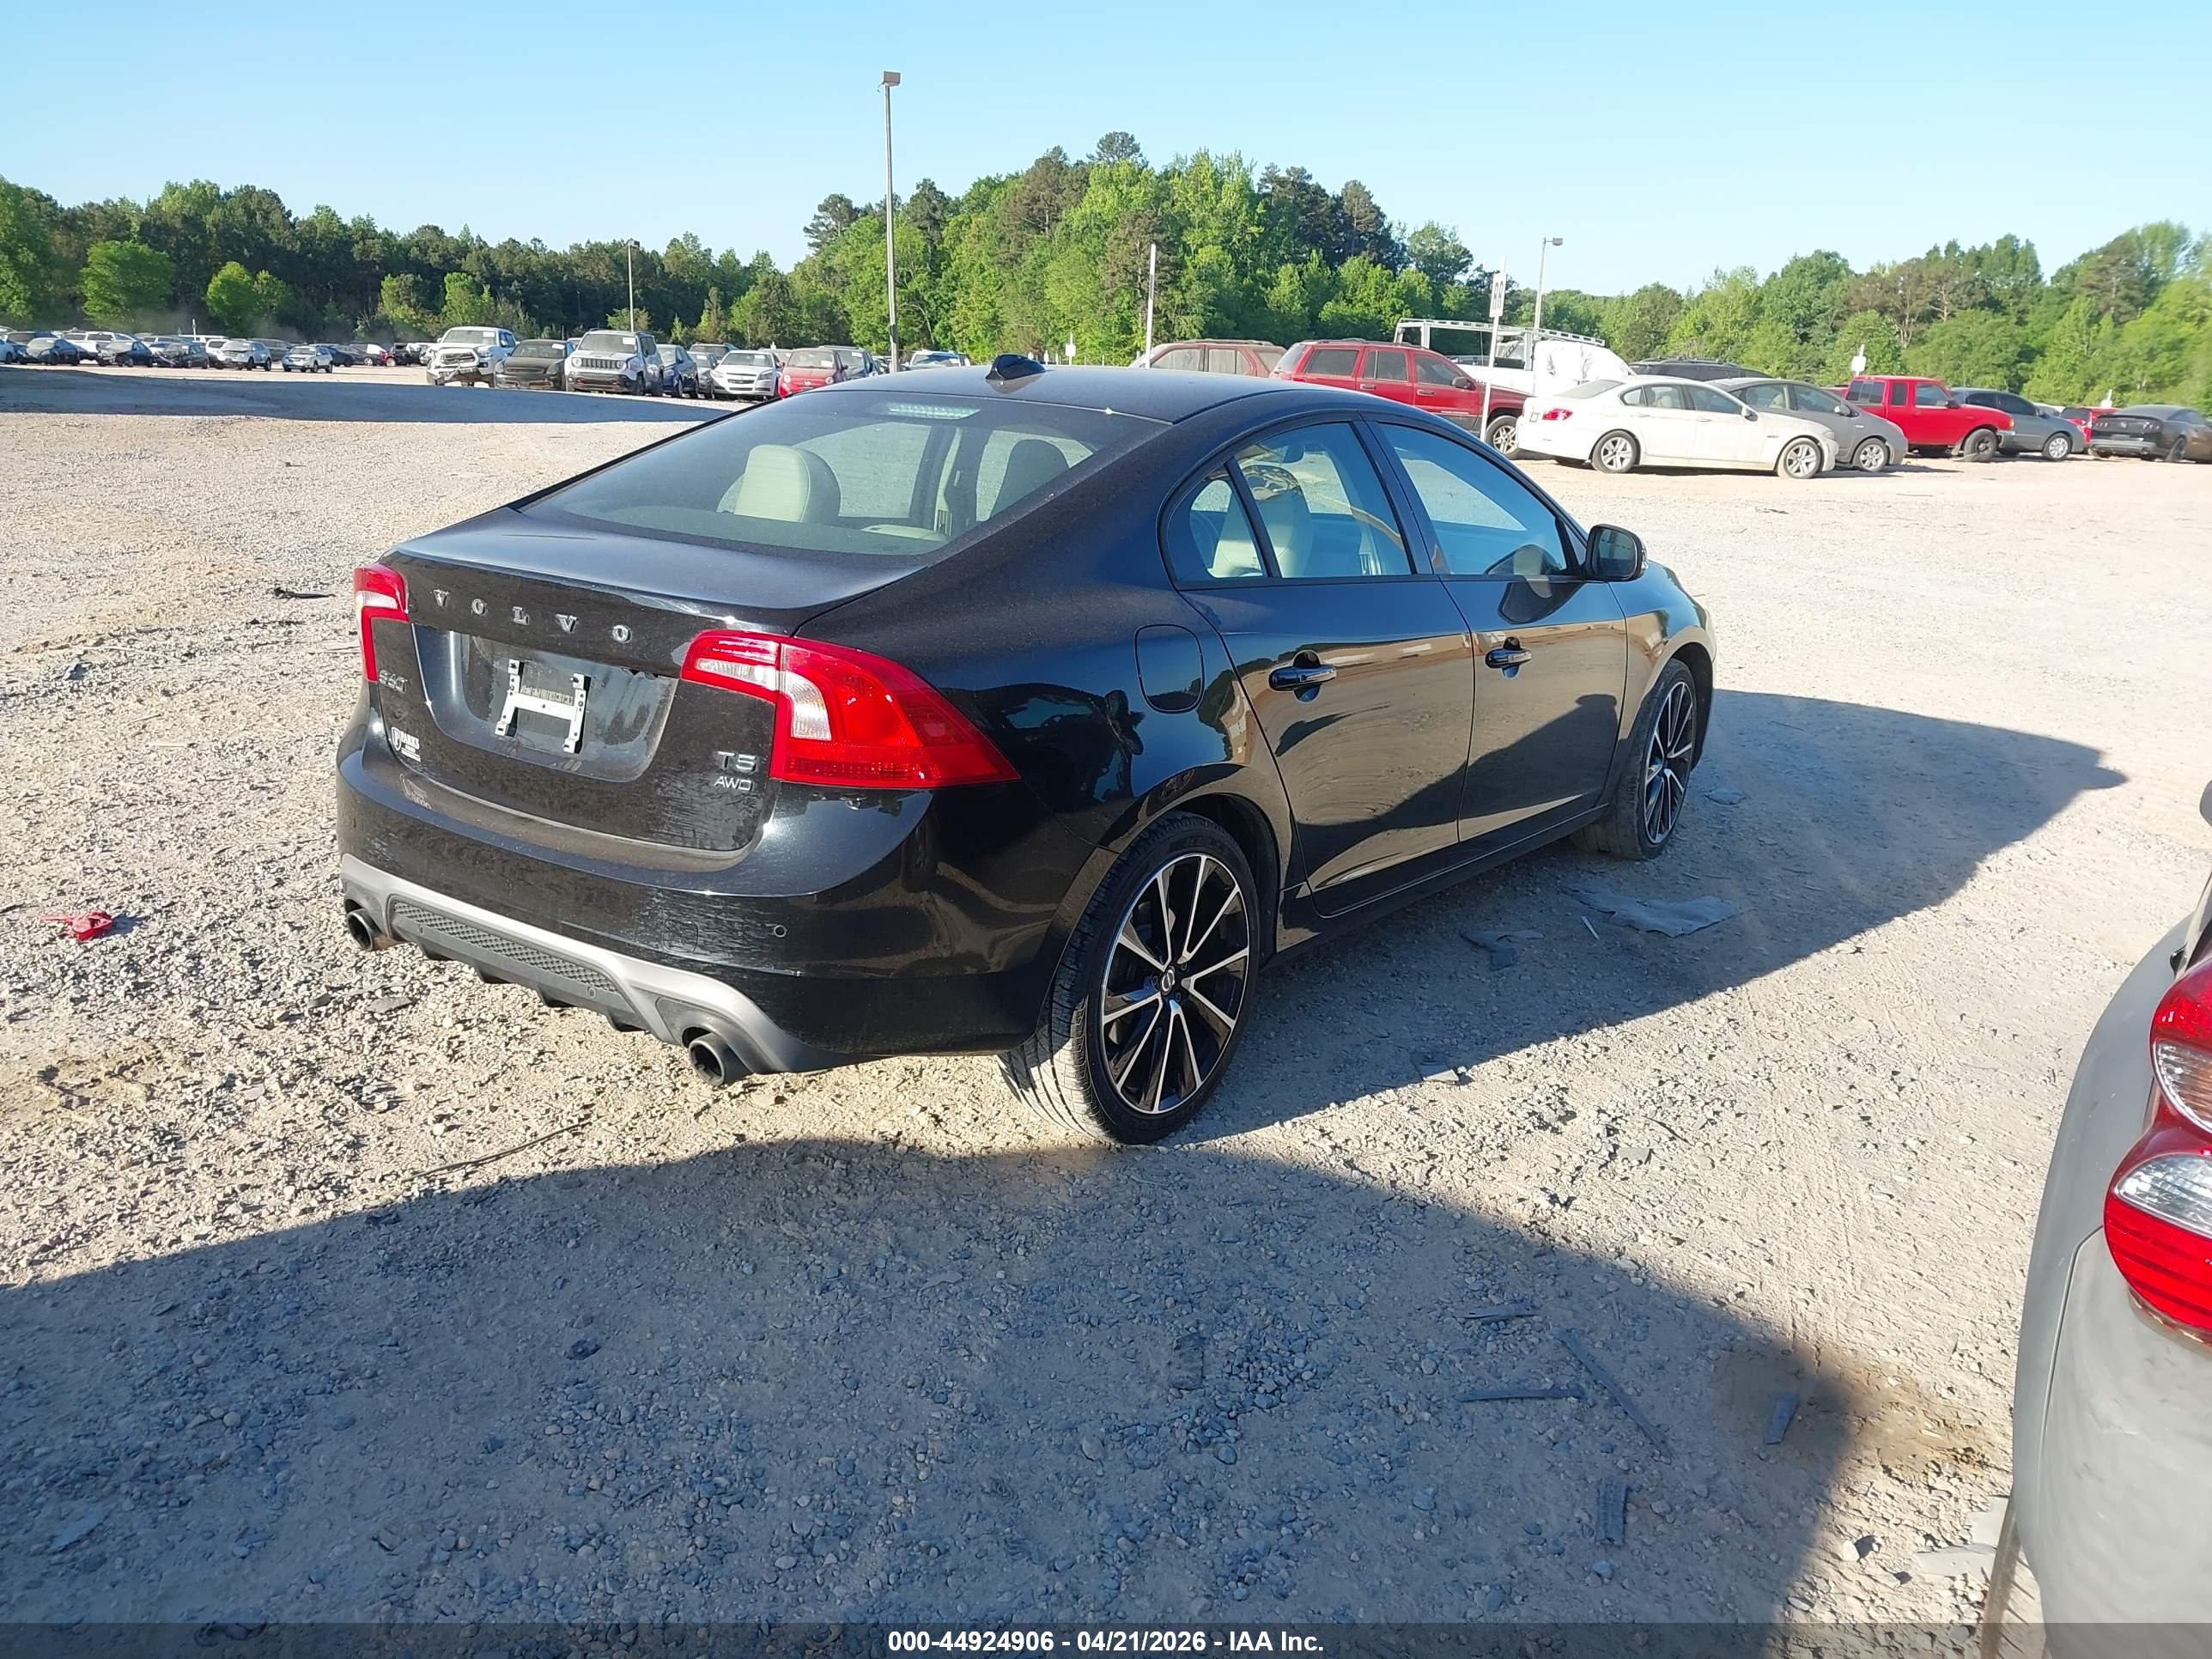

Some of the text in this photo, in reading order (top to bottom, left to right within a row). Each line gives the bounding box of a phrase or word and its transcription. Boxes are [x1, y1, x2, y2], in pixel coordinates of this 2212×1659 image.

[433, 588, 632, 644] VOLVO
[717, 750, 757, 774] T5
[714, 775, 754, 792] AWD
